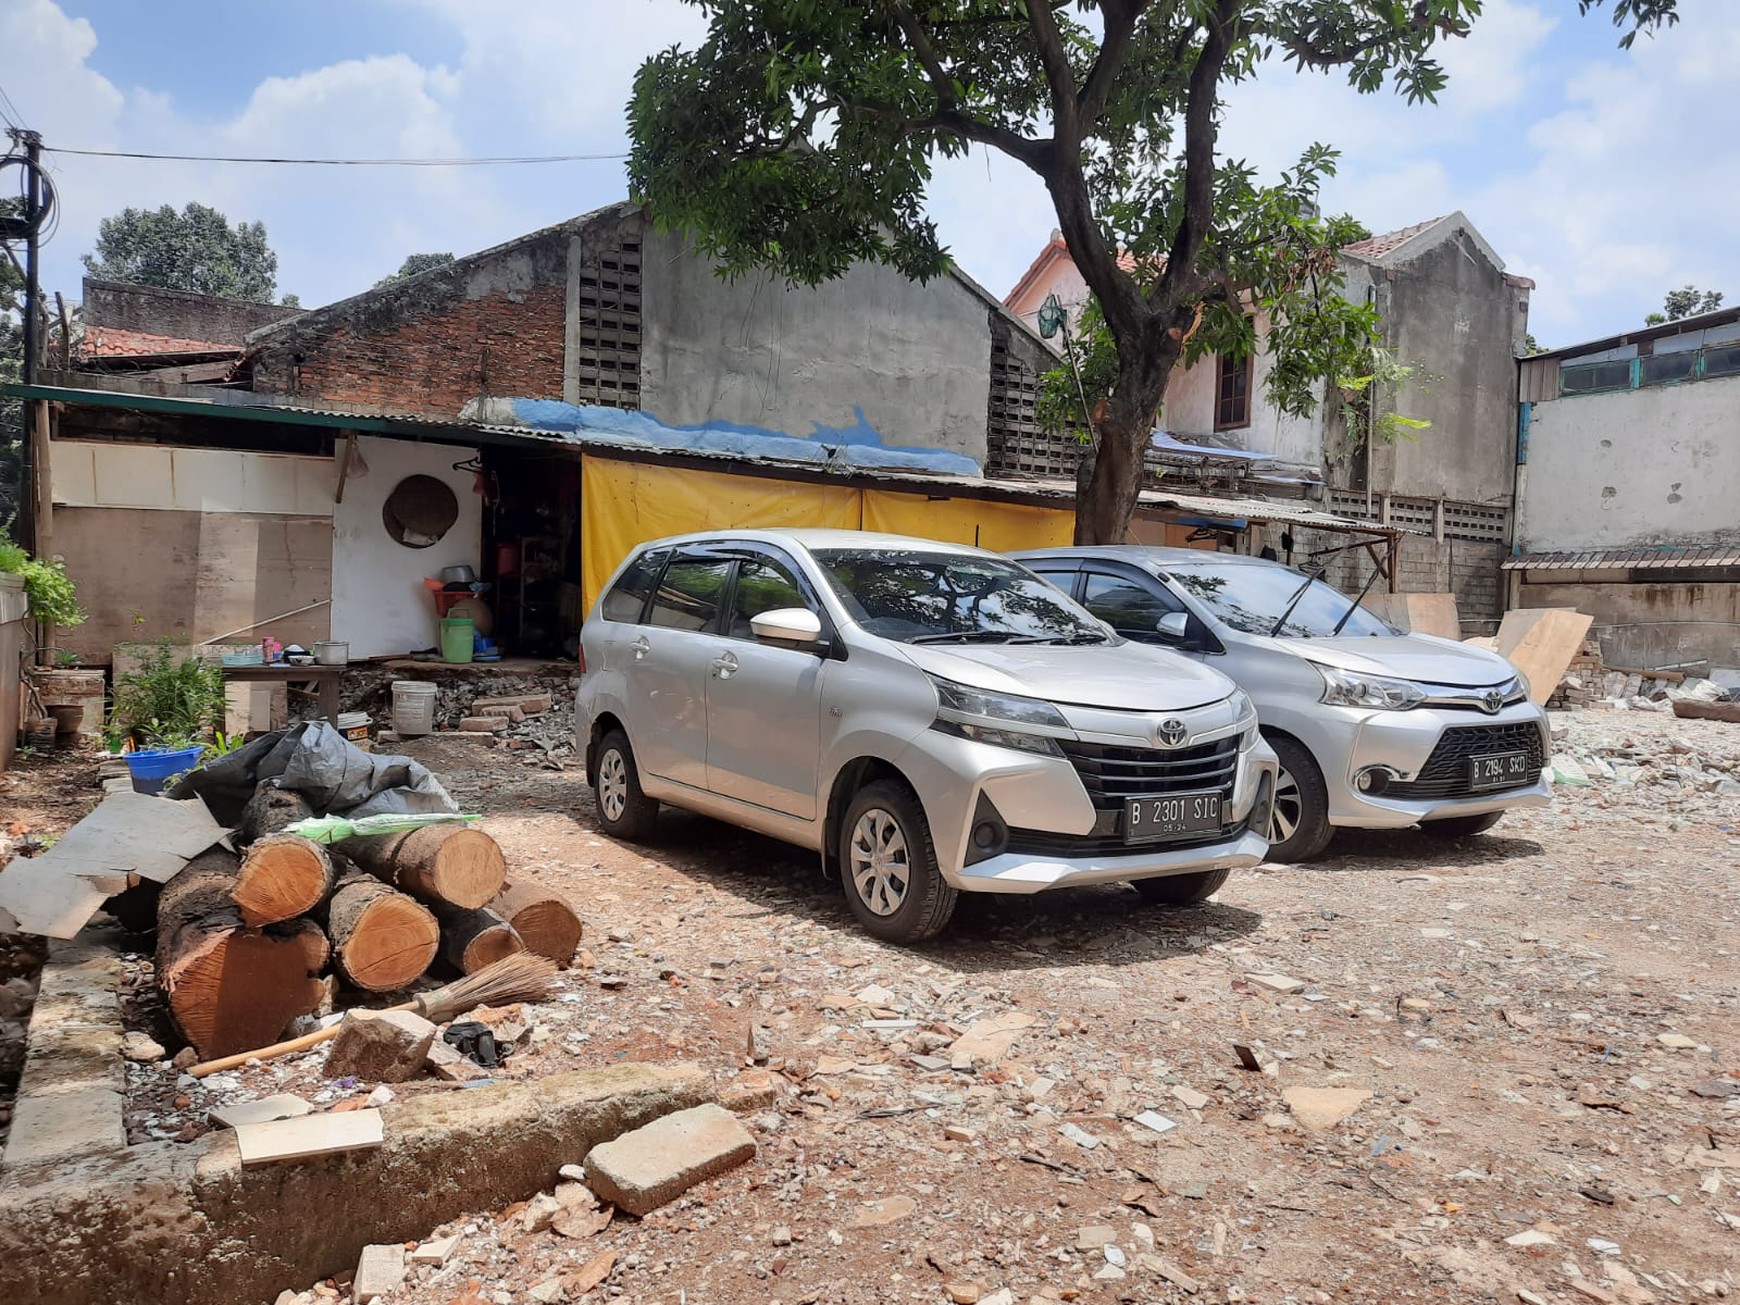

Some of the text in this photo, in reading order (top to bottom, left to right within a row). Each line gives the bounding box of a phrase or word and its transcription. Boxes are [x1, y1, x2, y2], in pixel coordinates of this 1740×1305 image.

[1474, 761, 1479, 779] B
[1132, 798, 1217, 824] B 2301 SIC
